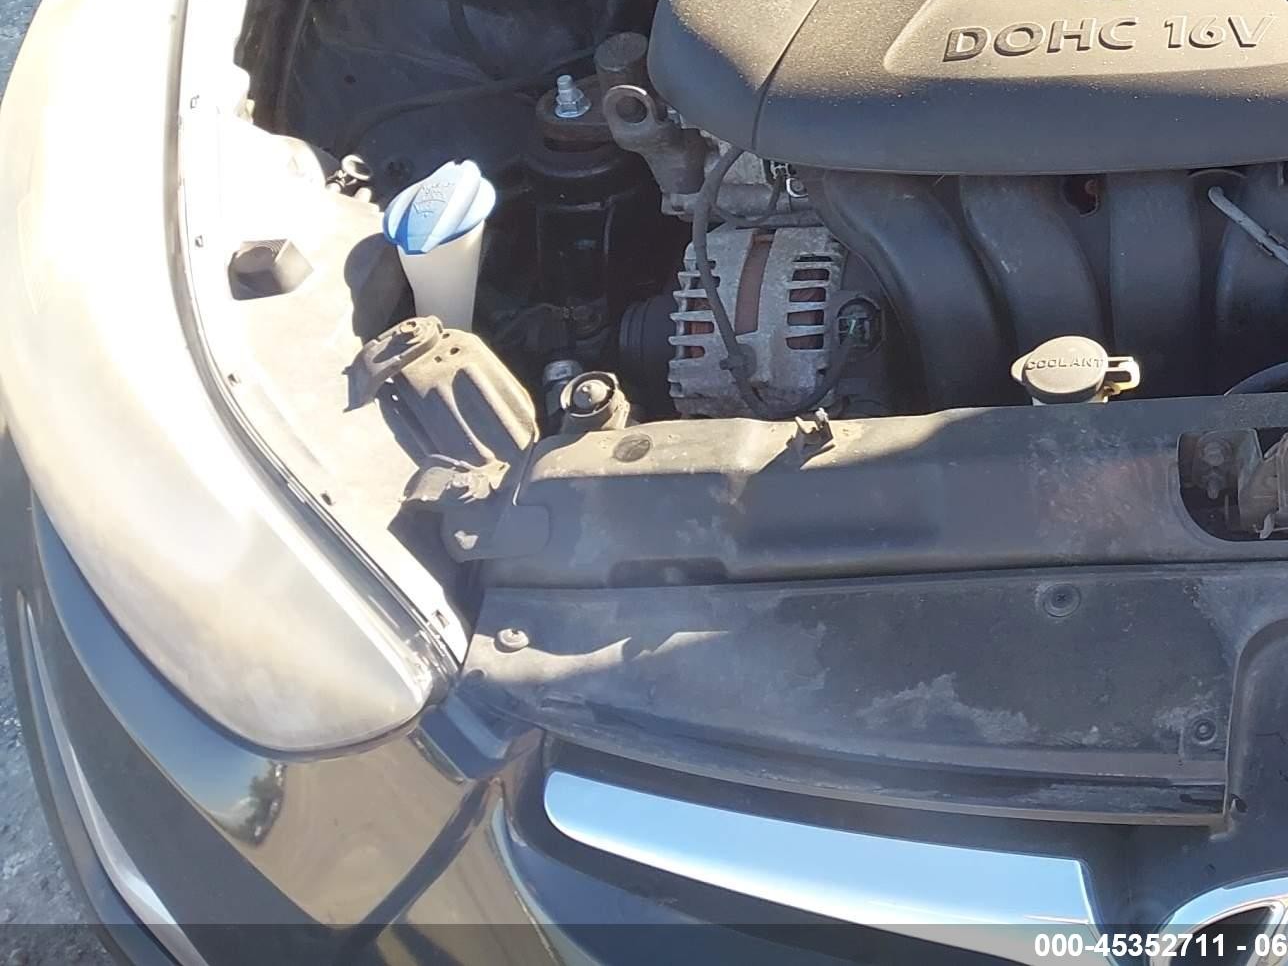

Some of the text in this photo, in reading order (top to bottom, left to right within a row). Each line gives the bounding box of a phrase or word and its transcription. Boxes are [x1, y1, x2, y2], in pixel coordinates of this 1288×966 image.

[942, 14, 1274, 62] DOHC 16V
[1025, 355, 1104, 370] COOLANT
